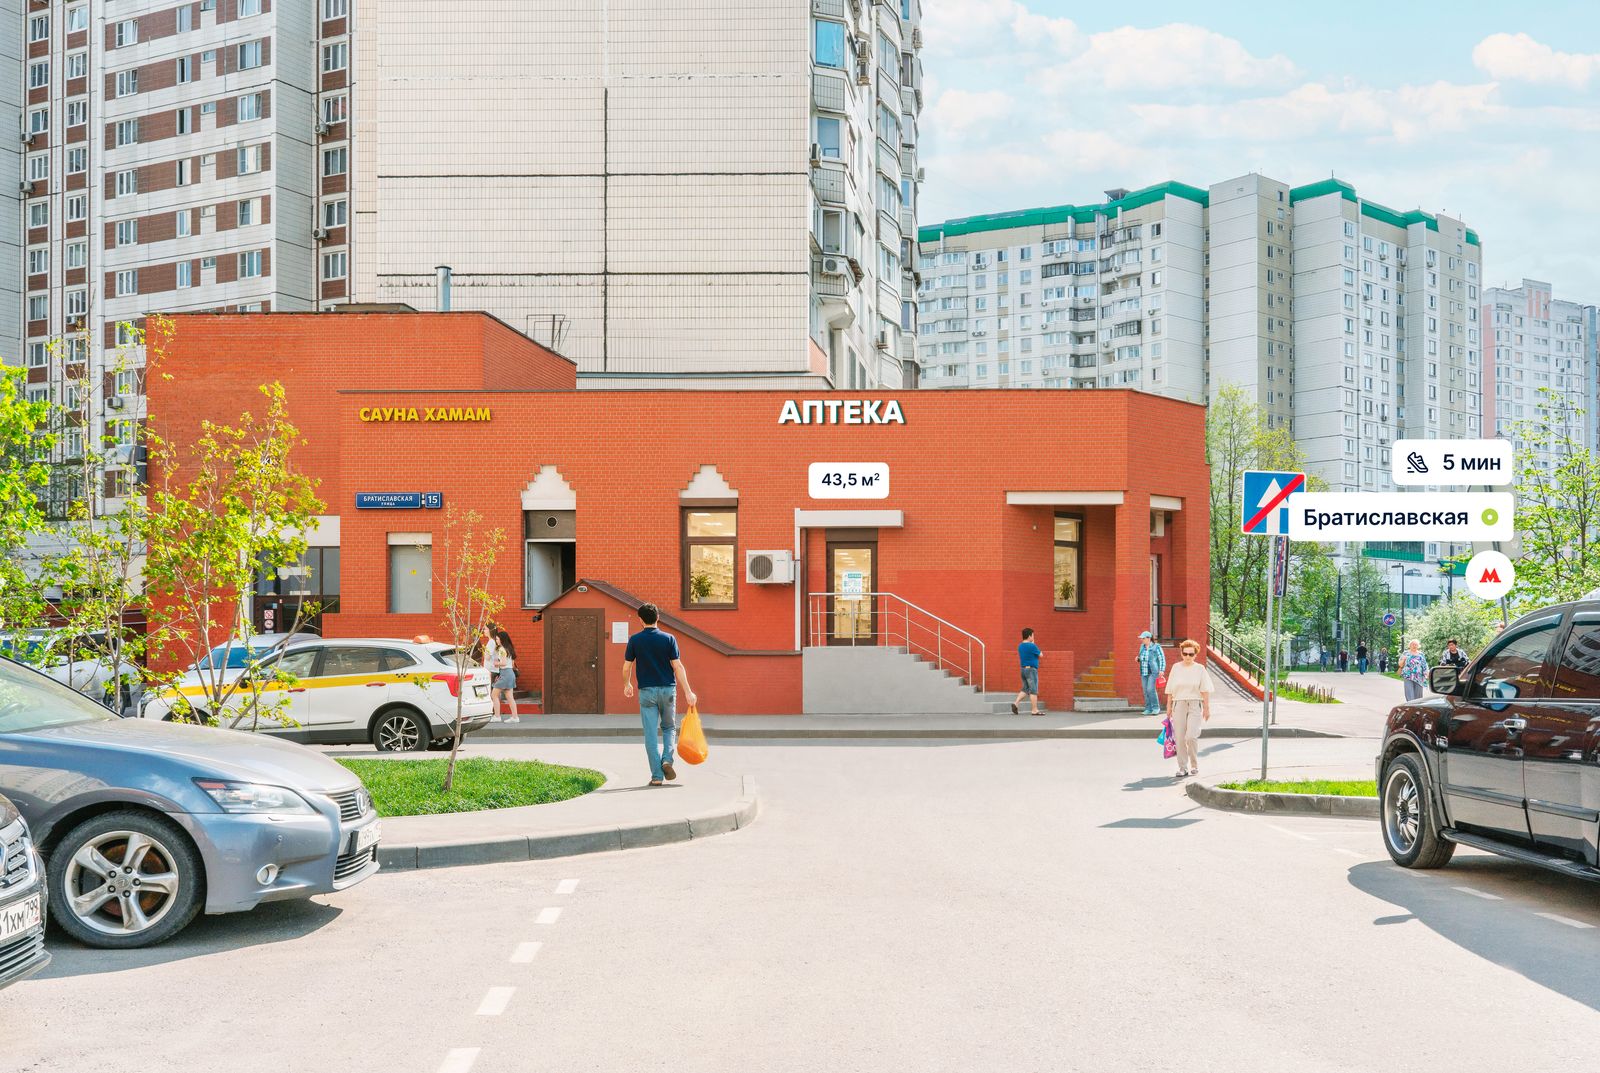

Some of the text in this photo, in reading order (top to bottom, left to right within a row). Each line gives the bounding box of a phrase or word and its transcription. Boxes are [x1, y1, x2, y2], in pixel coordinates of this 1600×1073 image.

[359, 407, 492, 422] САУНА ХАМАМ
[777, 399, 906, 425] АПТЕКА
[427, 495, 438, 504] 15
